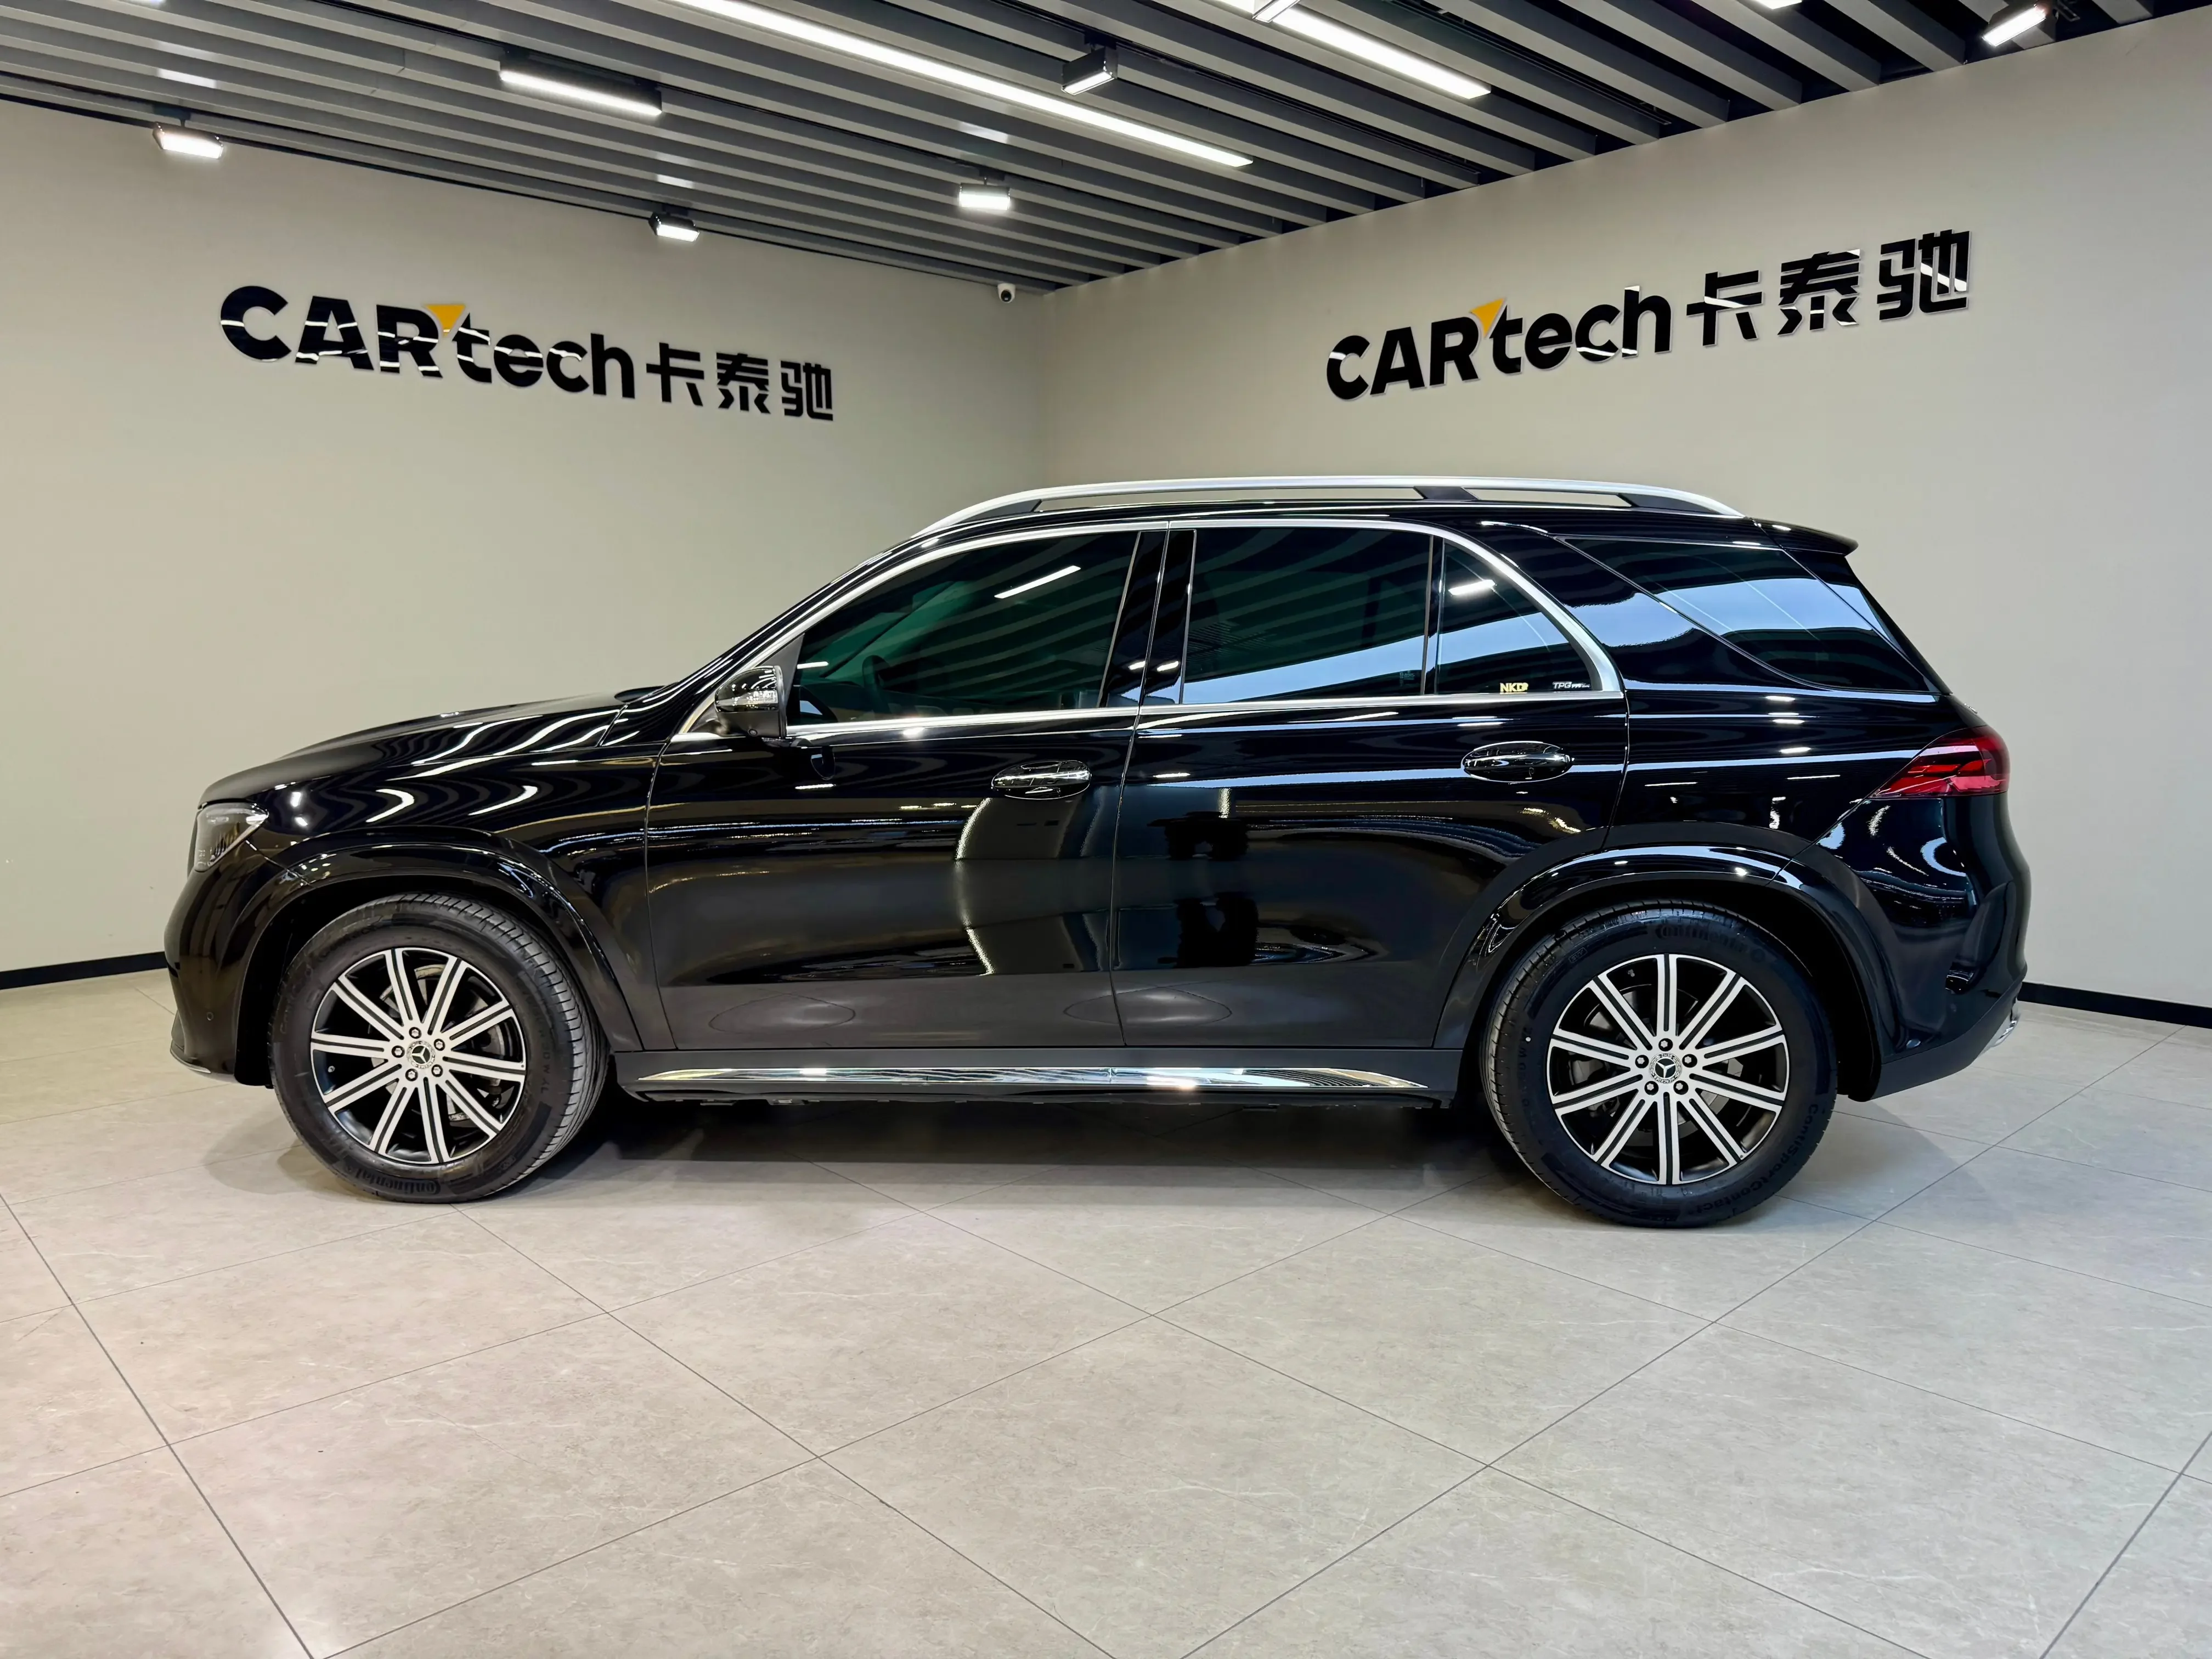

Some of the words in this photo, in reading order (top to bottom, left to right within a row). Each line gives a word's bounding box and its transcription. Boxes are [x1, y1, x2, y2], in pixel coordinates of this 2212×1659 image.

[219, 285, 636, 399] CARtech
[646, 343, 833, 421] 卡泰驰
[1325, 286, 1672, 400] CARtech
[1686, 229, 1971, 347] 卡泰驰
